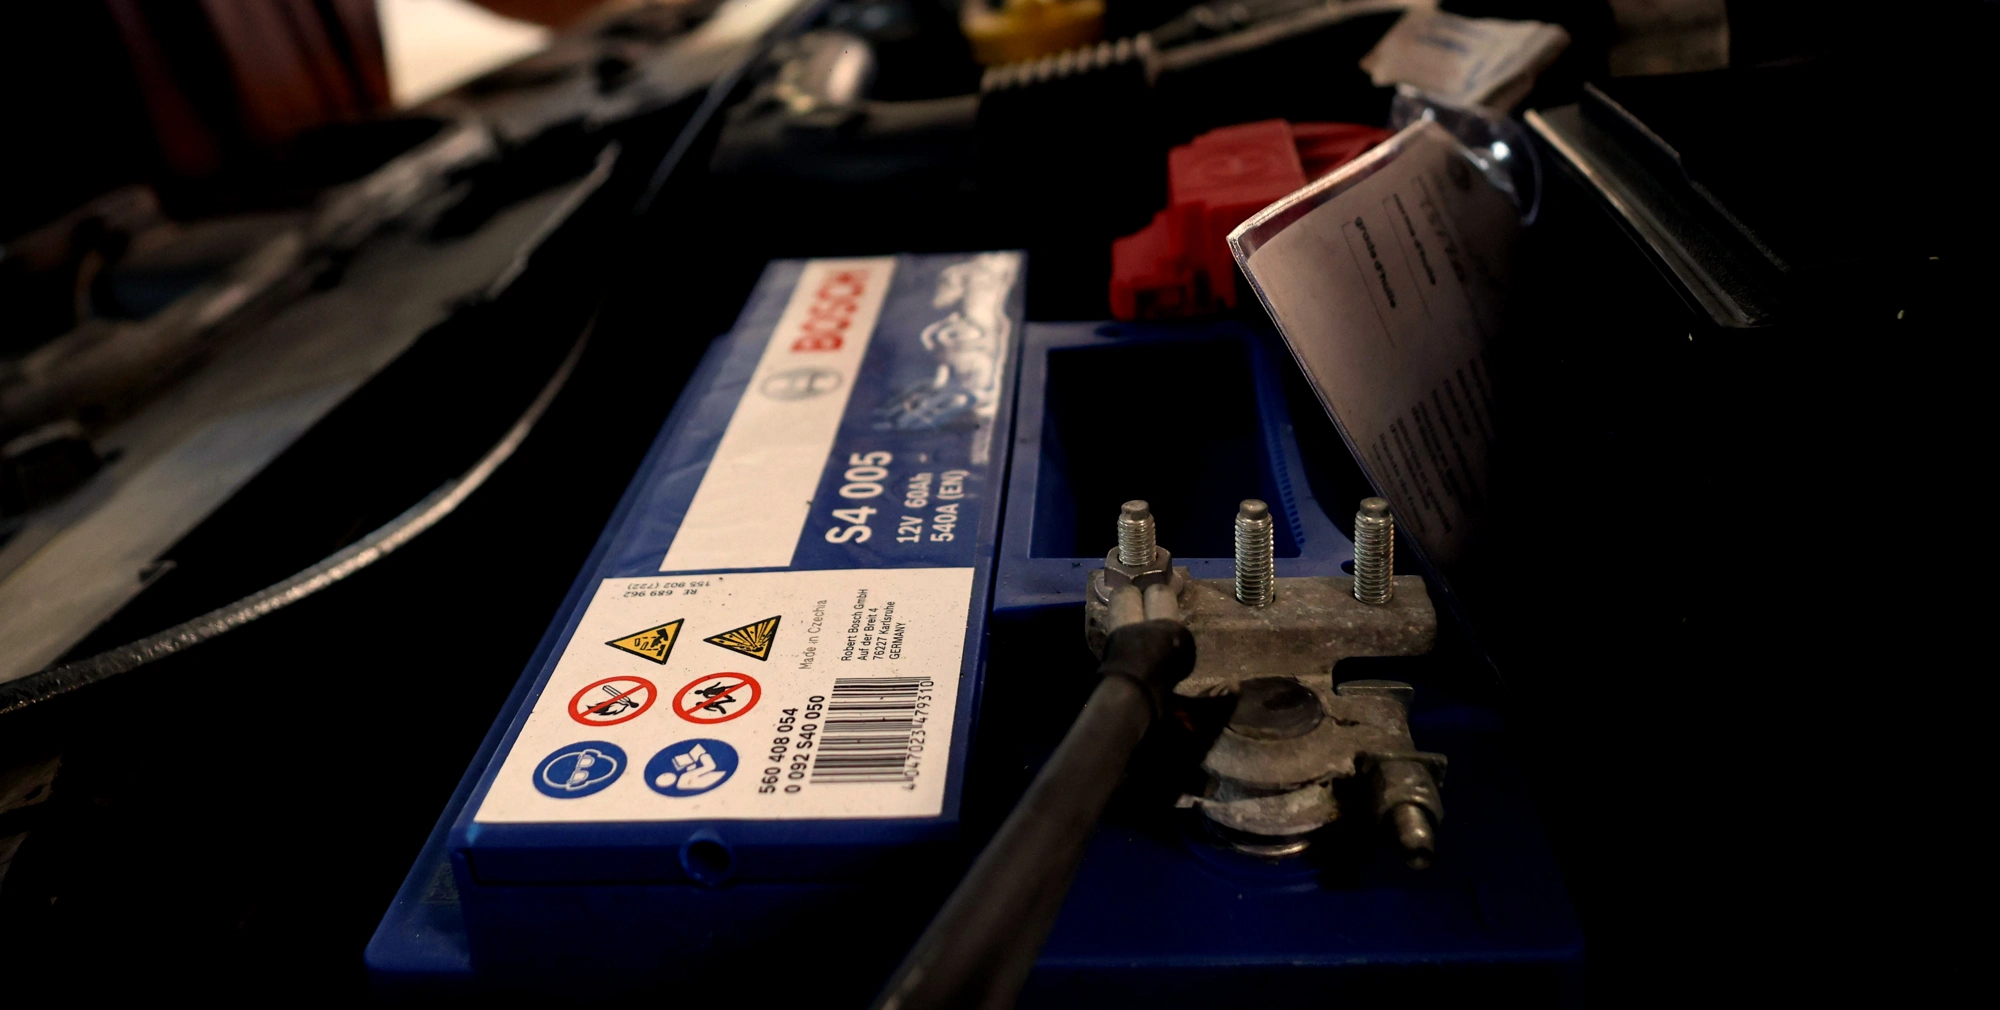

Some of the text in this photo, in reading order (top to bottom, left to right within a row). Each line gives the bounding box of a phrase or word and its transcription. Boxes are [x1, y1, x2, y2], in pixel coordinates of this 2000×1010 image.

[1354, 216, 1377, 259] grade
[790, 267, 870, 353] BOSCH
[824, 451, 894, 544] S4 005
[896, 471, 934, 544] 12V 60Ah
[929, 469, 971, 543] 540A (EN)
[623, 588, 698, 598] RE 689 962
[840, 588, 868, 662] Robert Bosch GmbH
[864, 610, 878, 632] Breit
[798, 599, 828, 671] Made in Czechia
[857, 643, 870, 661] Auf
[860, 626, 873, 643] der
[872, 600, 896, 661] 76227 Karlsruhe
[889, 621, 907, 660] GERMANY
[914, 680, 935, 725] 479310
[758, 706, 800, 796] 560 408 054
[784, 694, 826, 795] 0 092 S40 050
